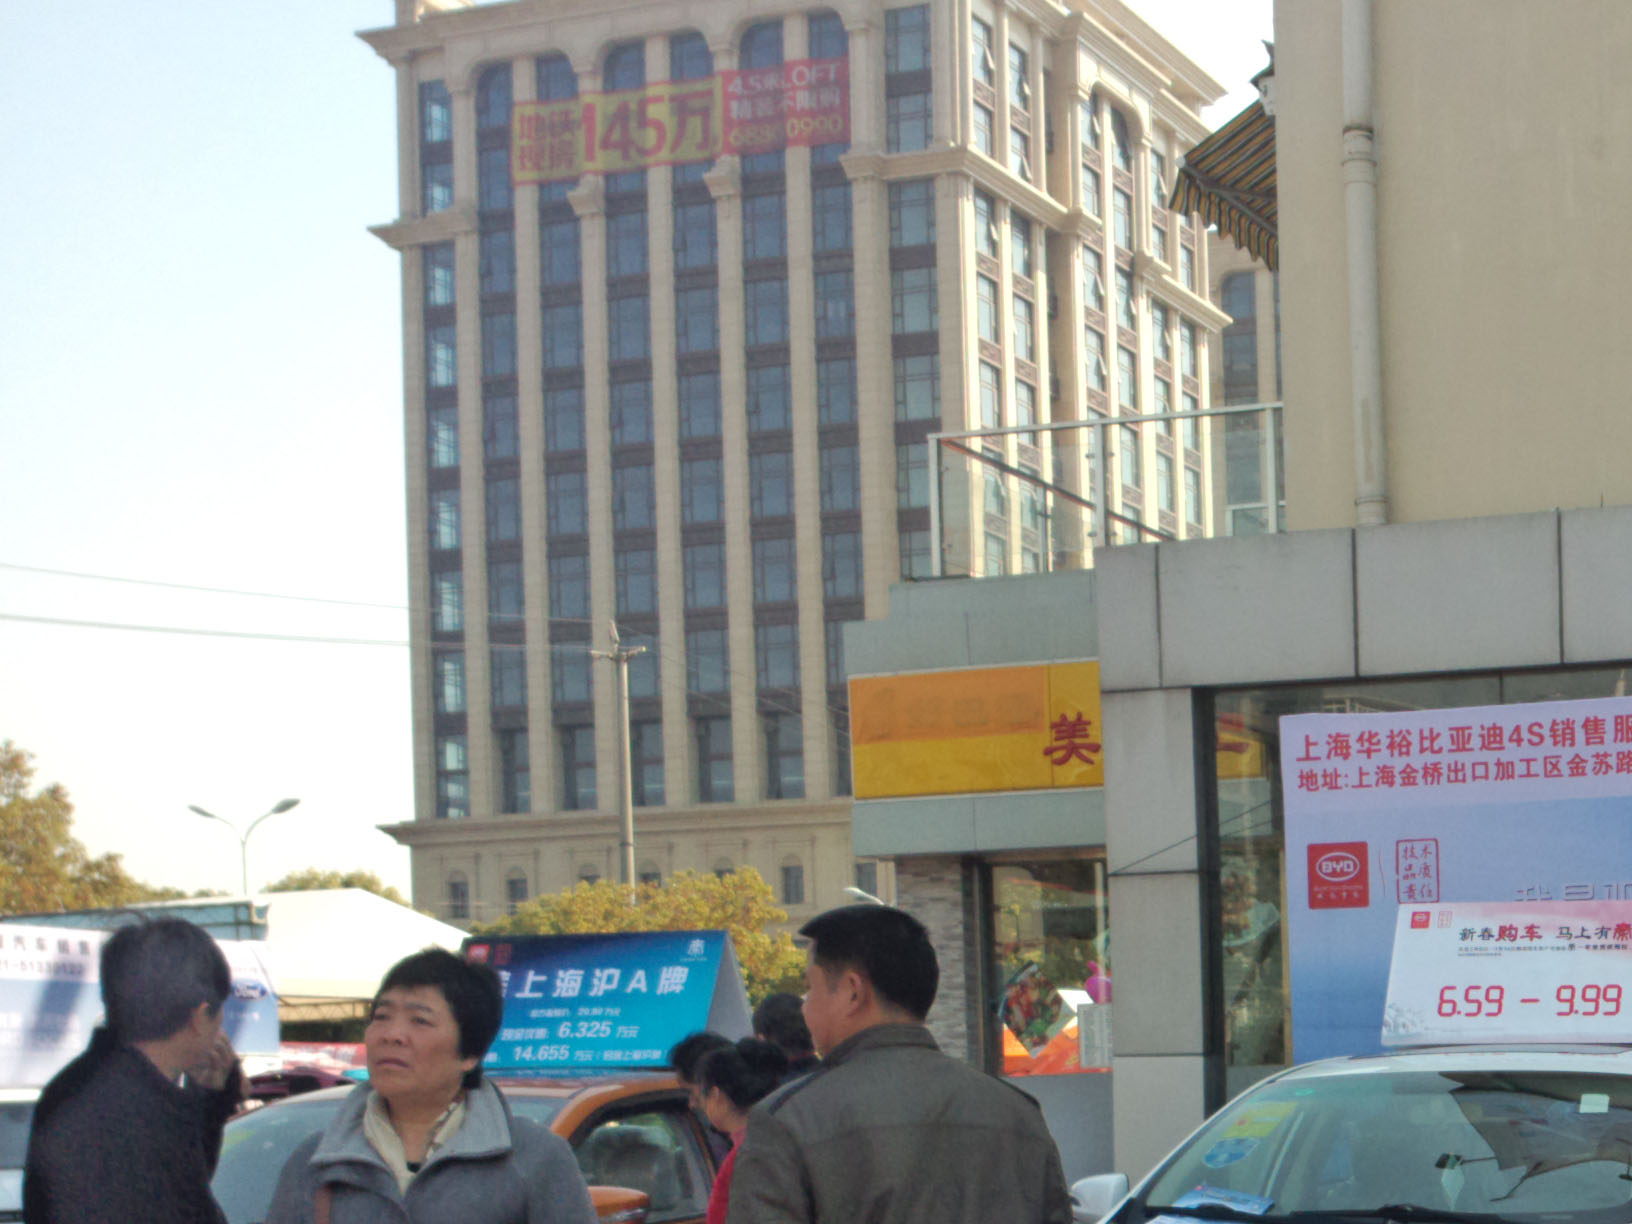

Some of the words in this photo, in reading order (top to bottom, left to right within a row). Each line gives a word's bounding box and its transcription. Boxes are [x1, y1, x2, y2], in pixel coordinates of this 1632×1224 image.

[581, 91, 715, 163] 145万
[1042, 711, 1102, 766] 美
[1321, 860, 1354, 873] BYD
[1437, 985, 1505, 1018] 6.59
[1555, 984, 1623, 1017] 9.99
[557, 1022, 613, 1038] 6.325
[514, 1047, 570, 1061] 14.655
